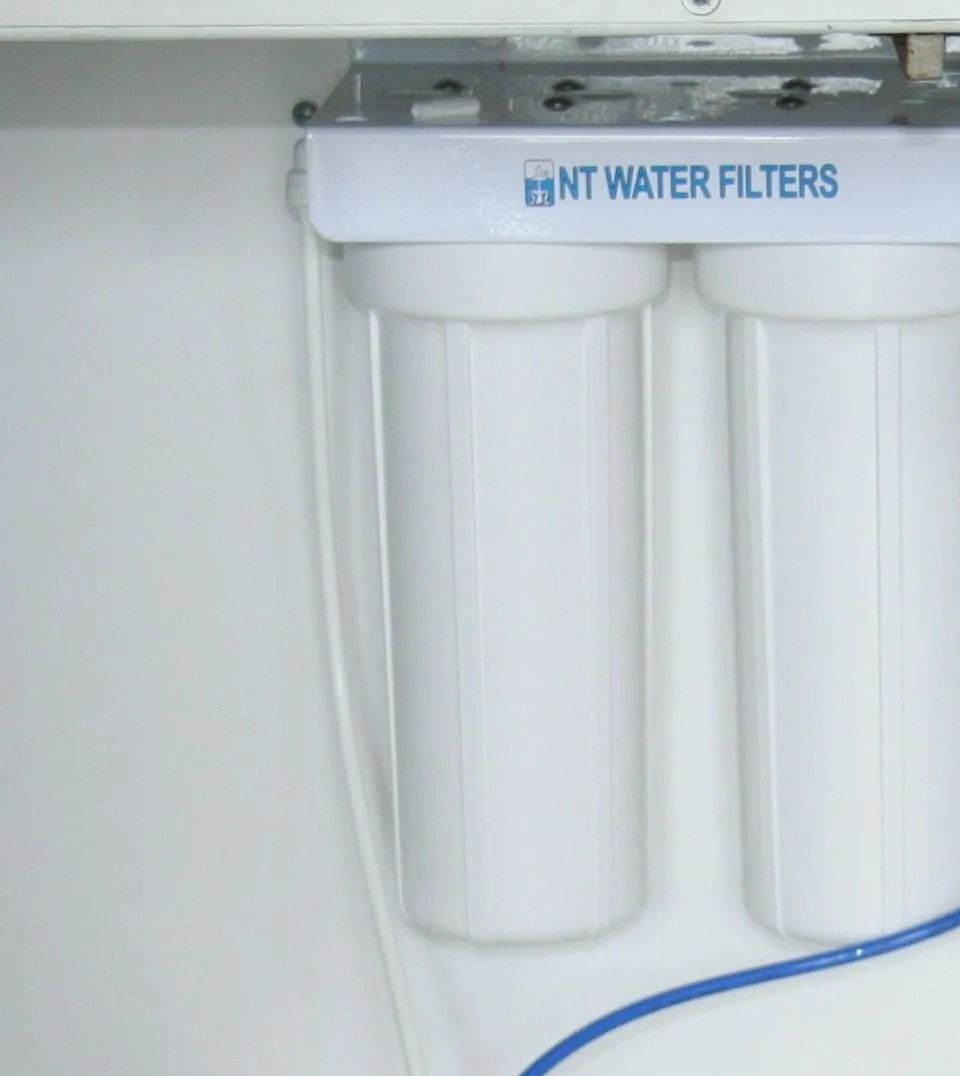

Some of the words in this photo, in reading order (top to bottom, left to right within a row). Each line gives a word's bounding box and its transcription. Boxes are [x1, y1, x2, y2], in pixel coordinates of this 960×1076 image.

[559, 166, 597, 200] NT
[604, 165, 710, 200] WATER
[719, 163, 838, 199] FILTERS
